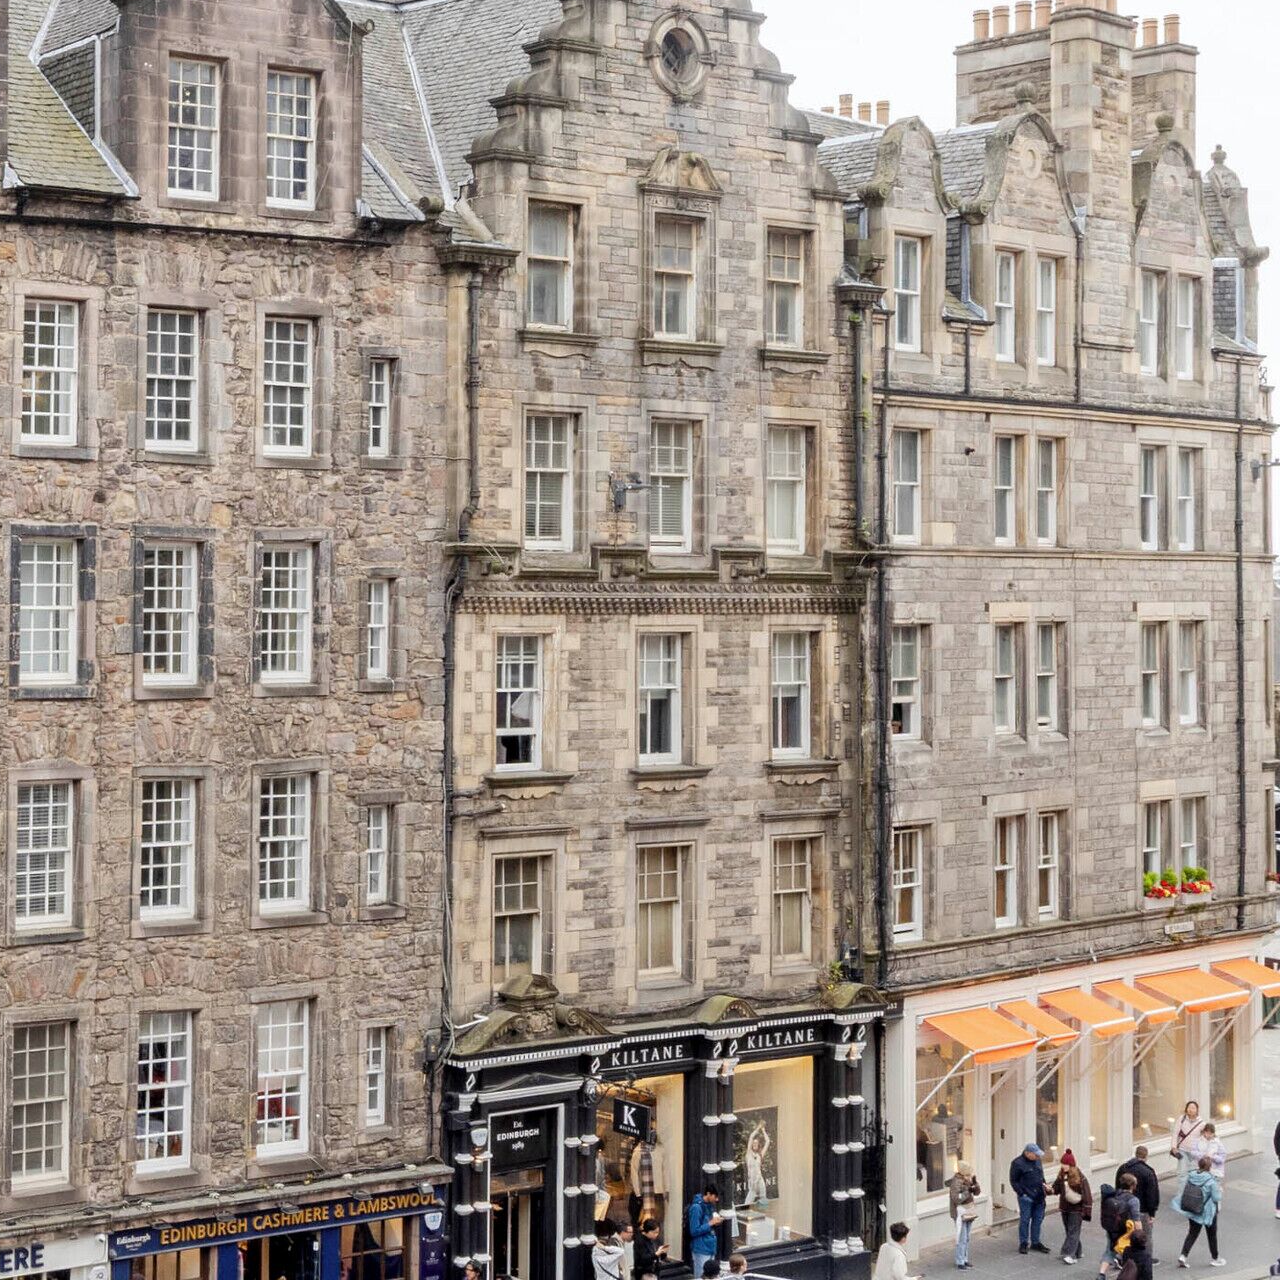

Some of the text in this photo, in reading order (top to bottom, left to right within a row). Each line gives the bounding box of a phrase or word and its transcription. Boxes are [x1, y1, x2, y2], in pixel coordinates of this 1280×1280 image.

[747, 1028, 815, 1049] KILTANE
[611, 1044, 684, 1066] KILTANE
[623, 1105, 636, 1127] K
[496, 1128, 540, 1141] EDINBURGH
[160, 1192, 439, 1246] EDINBURGH CASHMERE & LAMBSWOOL
